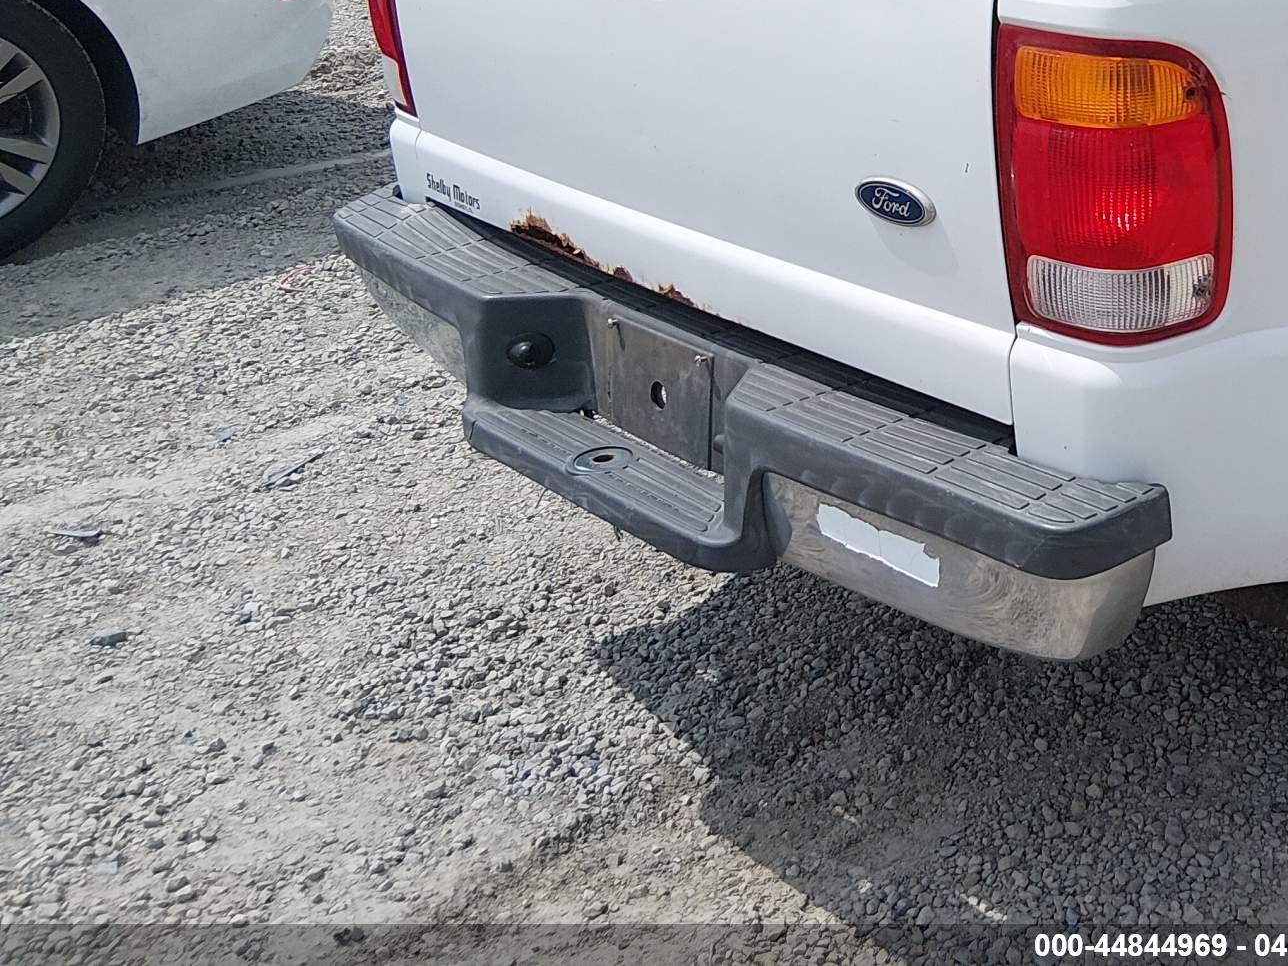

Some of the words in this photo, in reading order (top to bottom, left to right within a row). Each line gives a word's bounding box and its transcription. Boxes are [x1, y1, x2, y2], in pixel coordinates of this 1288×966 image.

[426, 172, 452, 202] Shelby
[453, 184, 481, 210] Motors
[872, 187, 911, 217] Ford
